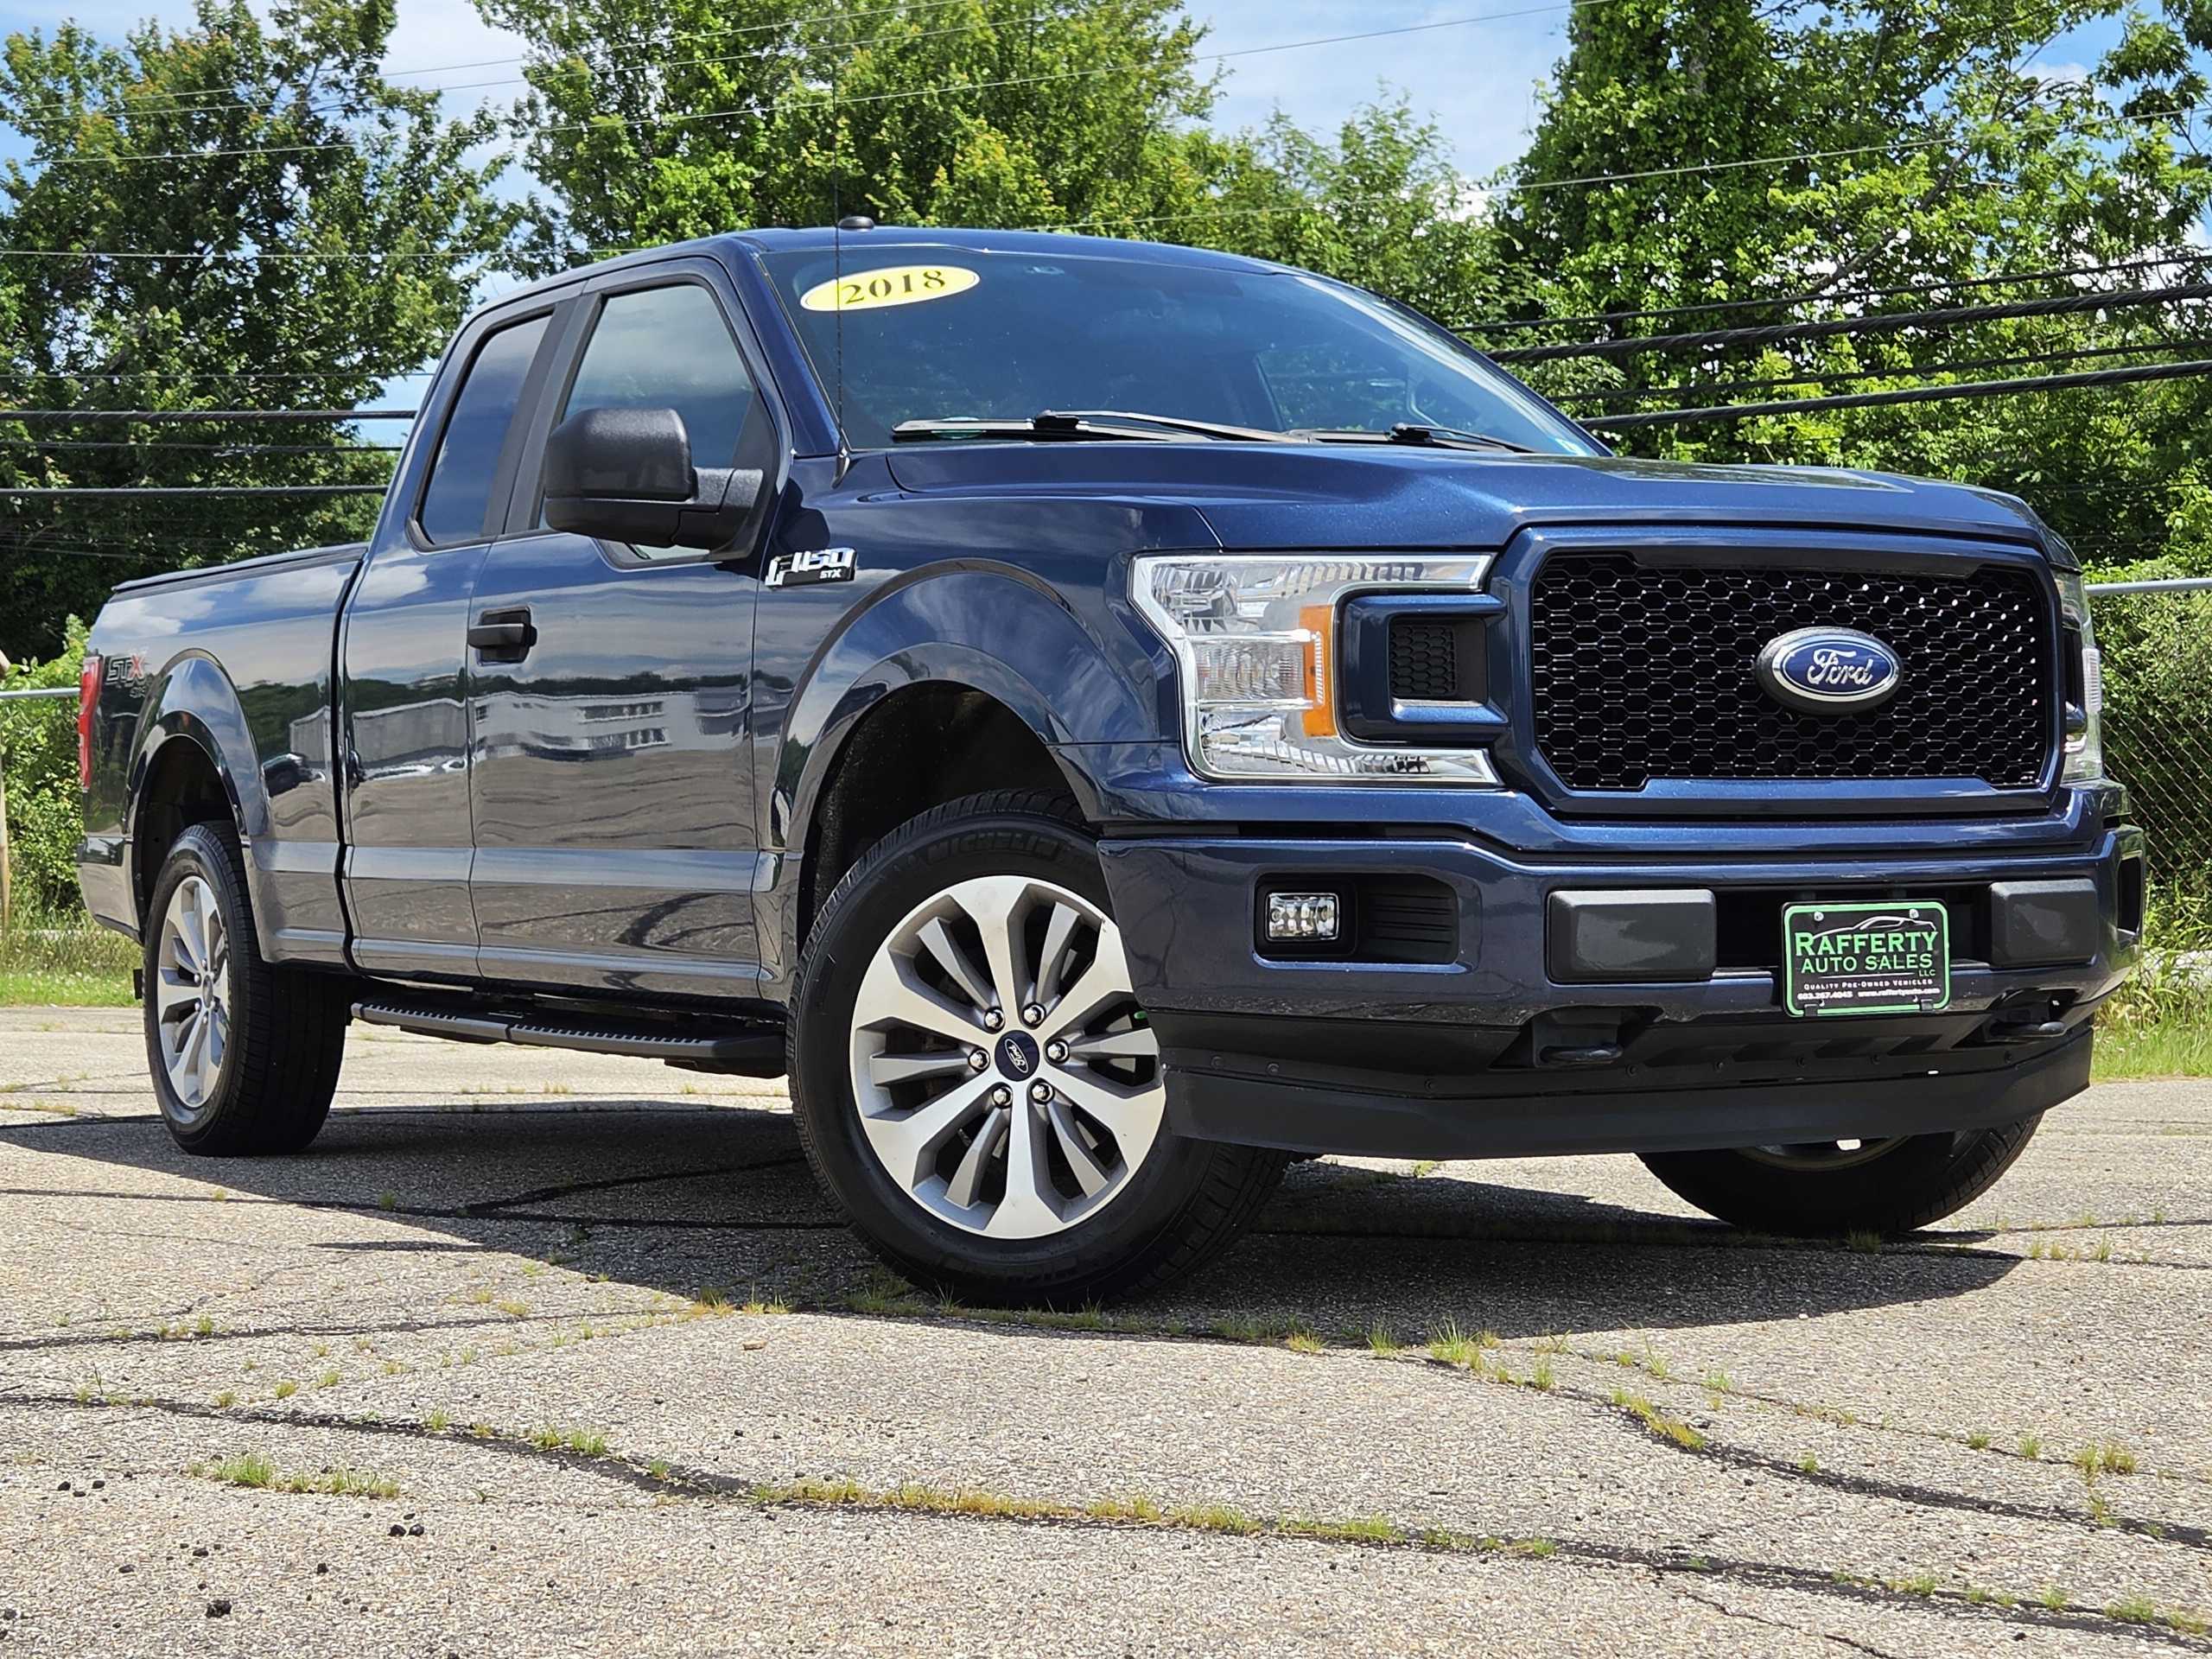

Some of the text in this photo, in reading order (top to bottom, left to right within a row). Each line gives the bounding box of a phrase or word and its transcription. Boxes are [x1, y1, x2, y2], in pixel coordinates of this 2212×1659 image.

[842, 270, 946, 304] 2018
[819, 569, 842, 580] STX
[1807, 648, 1874, 685] Ford
[1795, 931, 1939, 957] RAFFERTY
[1801, 953, 1933, 974] AUTO SALES
[1918, 969, 1936, 977] LLC
[1803, 982, 1839, 991] QUALITY
[1008, 1044, 1026, 1066] Ford
